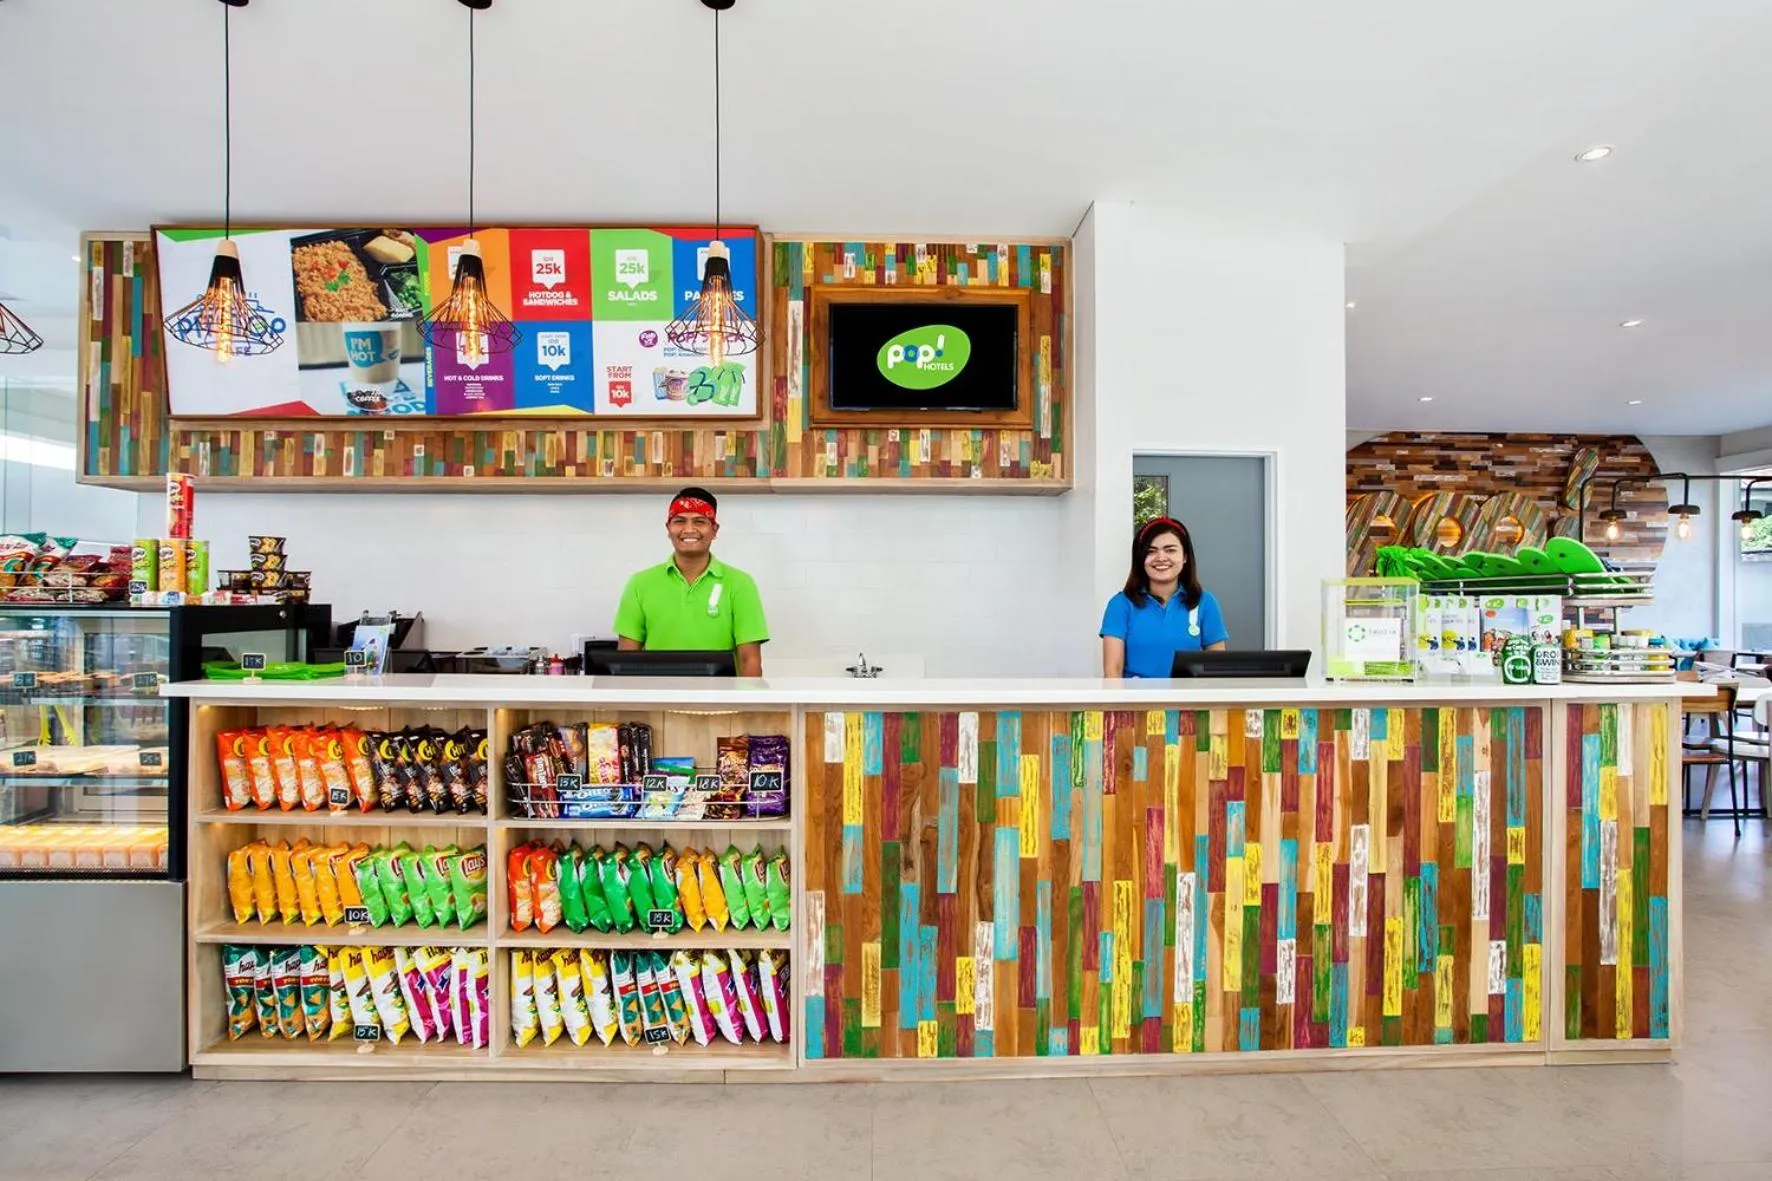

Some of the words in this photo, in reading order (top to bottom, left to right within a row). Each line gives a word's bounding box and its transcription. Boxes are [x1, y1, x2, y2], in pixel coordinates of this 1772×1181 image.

[535, 262, 562, 275] 25k
[619, 262, 645, 274] 25k
[607, 290, 658, 301] SALADS
[522, 298, 579, 306] SANDWICHES
[350, 337, 372, 351] I'M
[351, 350, 376, 362] HOT
[541, 345, 566, 357] 10k
[887, 334, 945, 369] pop!
[606, 365, 633, 373] START
[923, 362, 955, 371] HOTELS
[610, 389, 630, 399] 10k
[1535, 650, 1559, 658] DRO
[645, 777, 665, 790] 12K
[698, 778, 720, 790] 18K
[753, 774, 780, 789] 10K
[462, 853, 486, 874] Lay's
[348, 909, 369, 921] 10K
[356, 1026, 378, 1037] 15K
[649, 1030, 669, 1041] 15K
